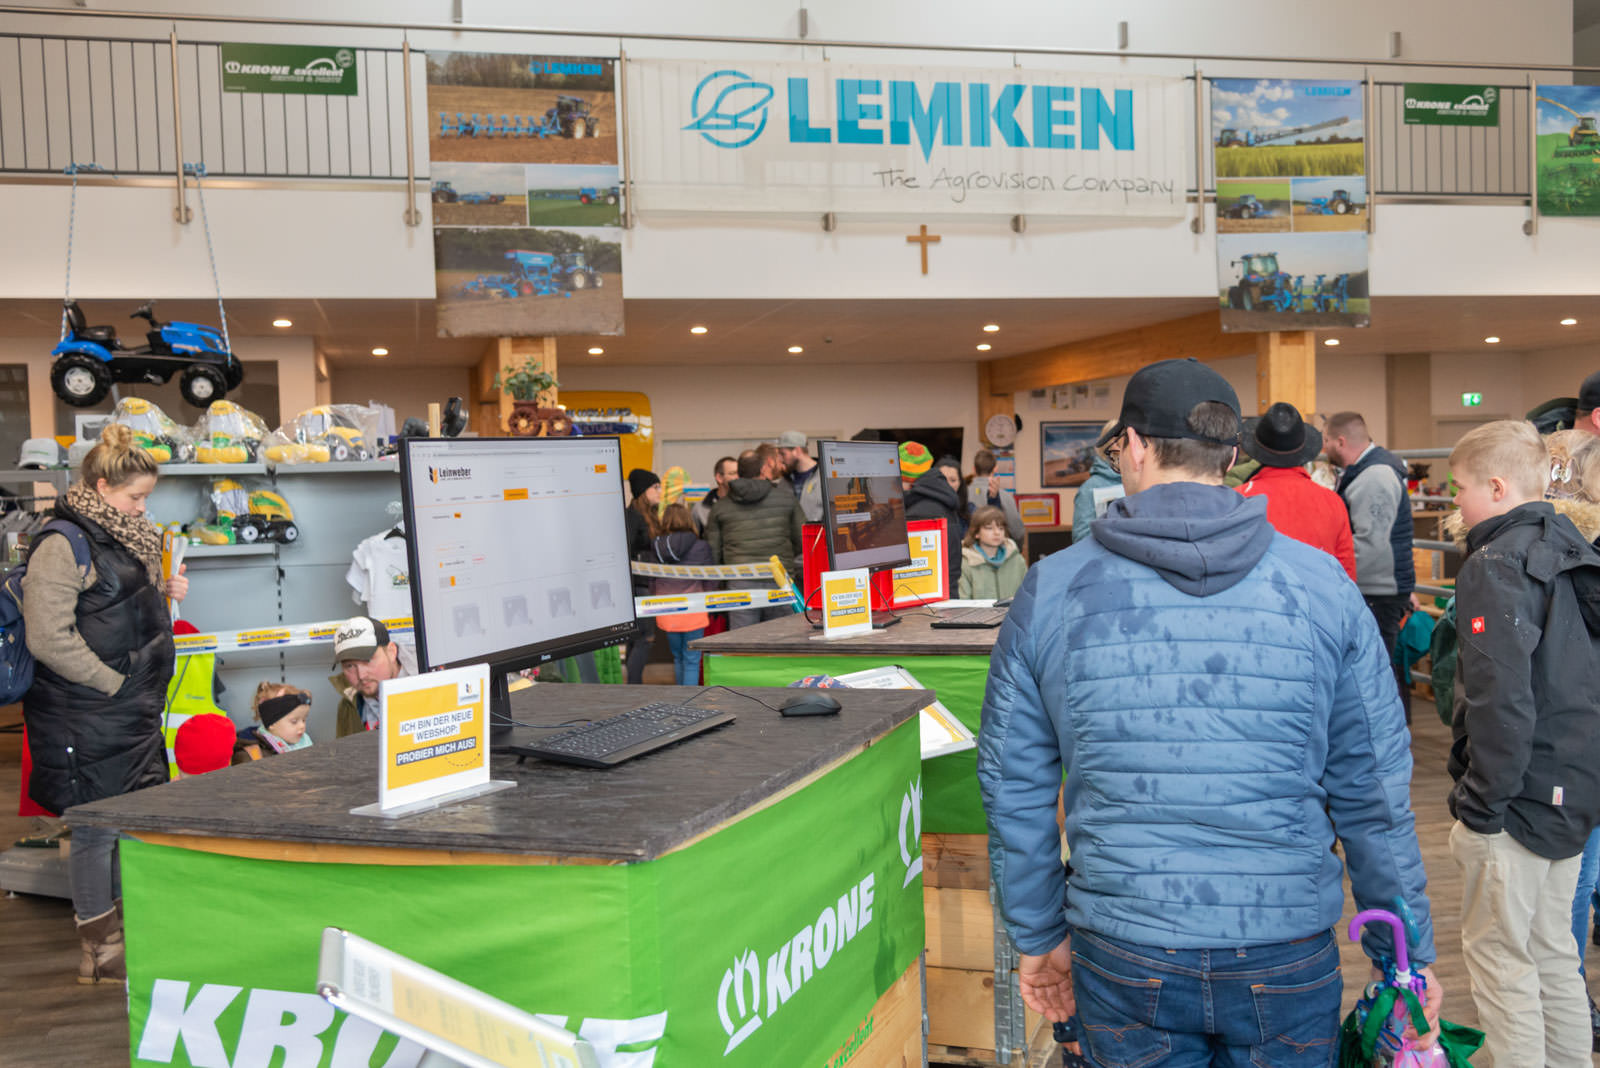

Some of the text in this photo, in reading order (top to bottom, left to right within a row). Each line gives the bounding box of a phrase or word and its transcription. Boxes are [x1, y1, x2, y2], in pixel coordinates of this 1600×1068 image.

[240, 64, 344, 77] KRONE excellent
[544, 62, 602, 75] LEMKEN
[787, 77, 1136, 164] LEMKEN
[873, 169, 920, 190] The
[930, 167, 1055, 203] Agrovision
[439, 467, 471, 478] Leinweber
[401, 710, 472, 733] ICH BIN DER NEUE
[397, 738, 476, 764] PROBIER MICH AUS!
[767, 872, 875, 1018] KRONE
[137, 978, 668, 1068] KROE
